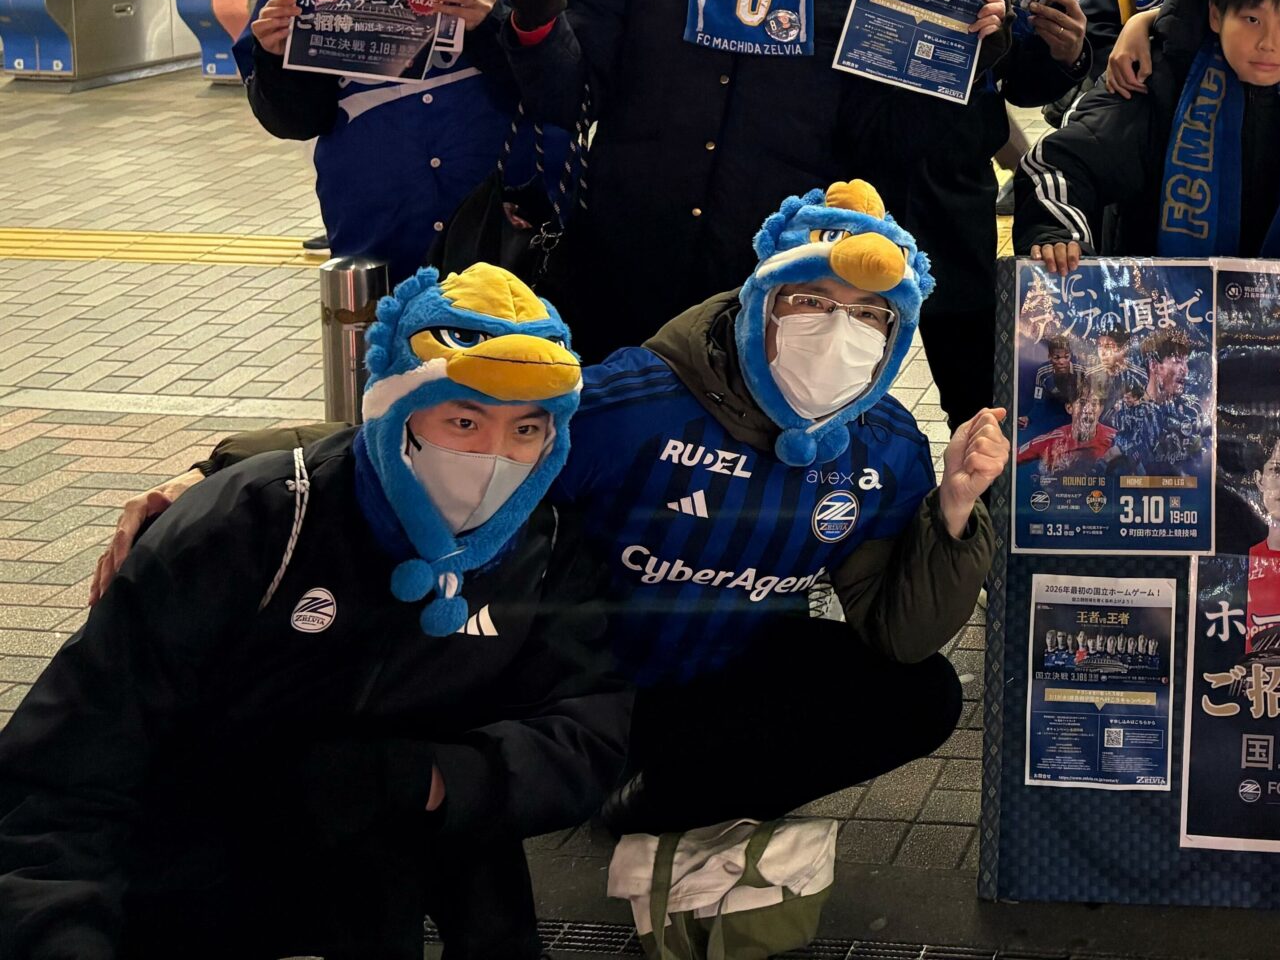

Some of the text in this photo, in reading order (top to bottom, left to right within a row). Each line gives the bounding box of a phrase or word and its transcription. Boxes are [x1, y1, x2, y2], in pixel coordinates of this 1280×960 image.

[696, 33, 803, 55] FC MACHIDA ZELVIA
[806, 470, 854, 486] avex
[1063, 476, 1106, 487] ROUND OF 16
[1120, 496, 1165, 524] 3.10
[1170, 511, 1198, 524] 19:00
[1047, 524, 1063, 536] 3.3
[621, 545, 827, 602] CyberAgent
